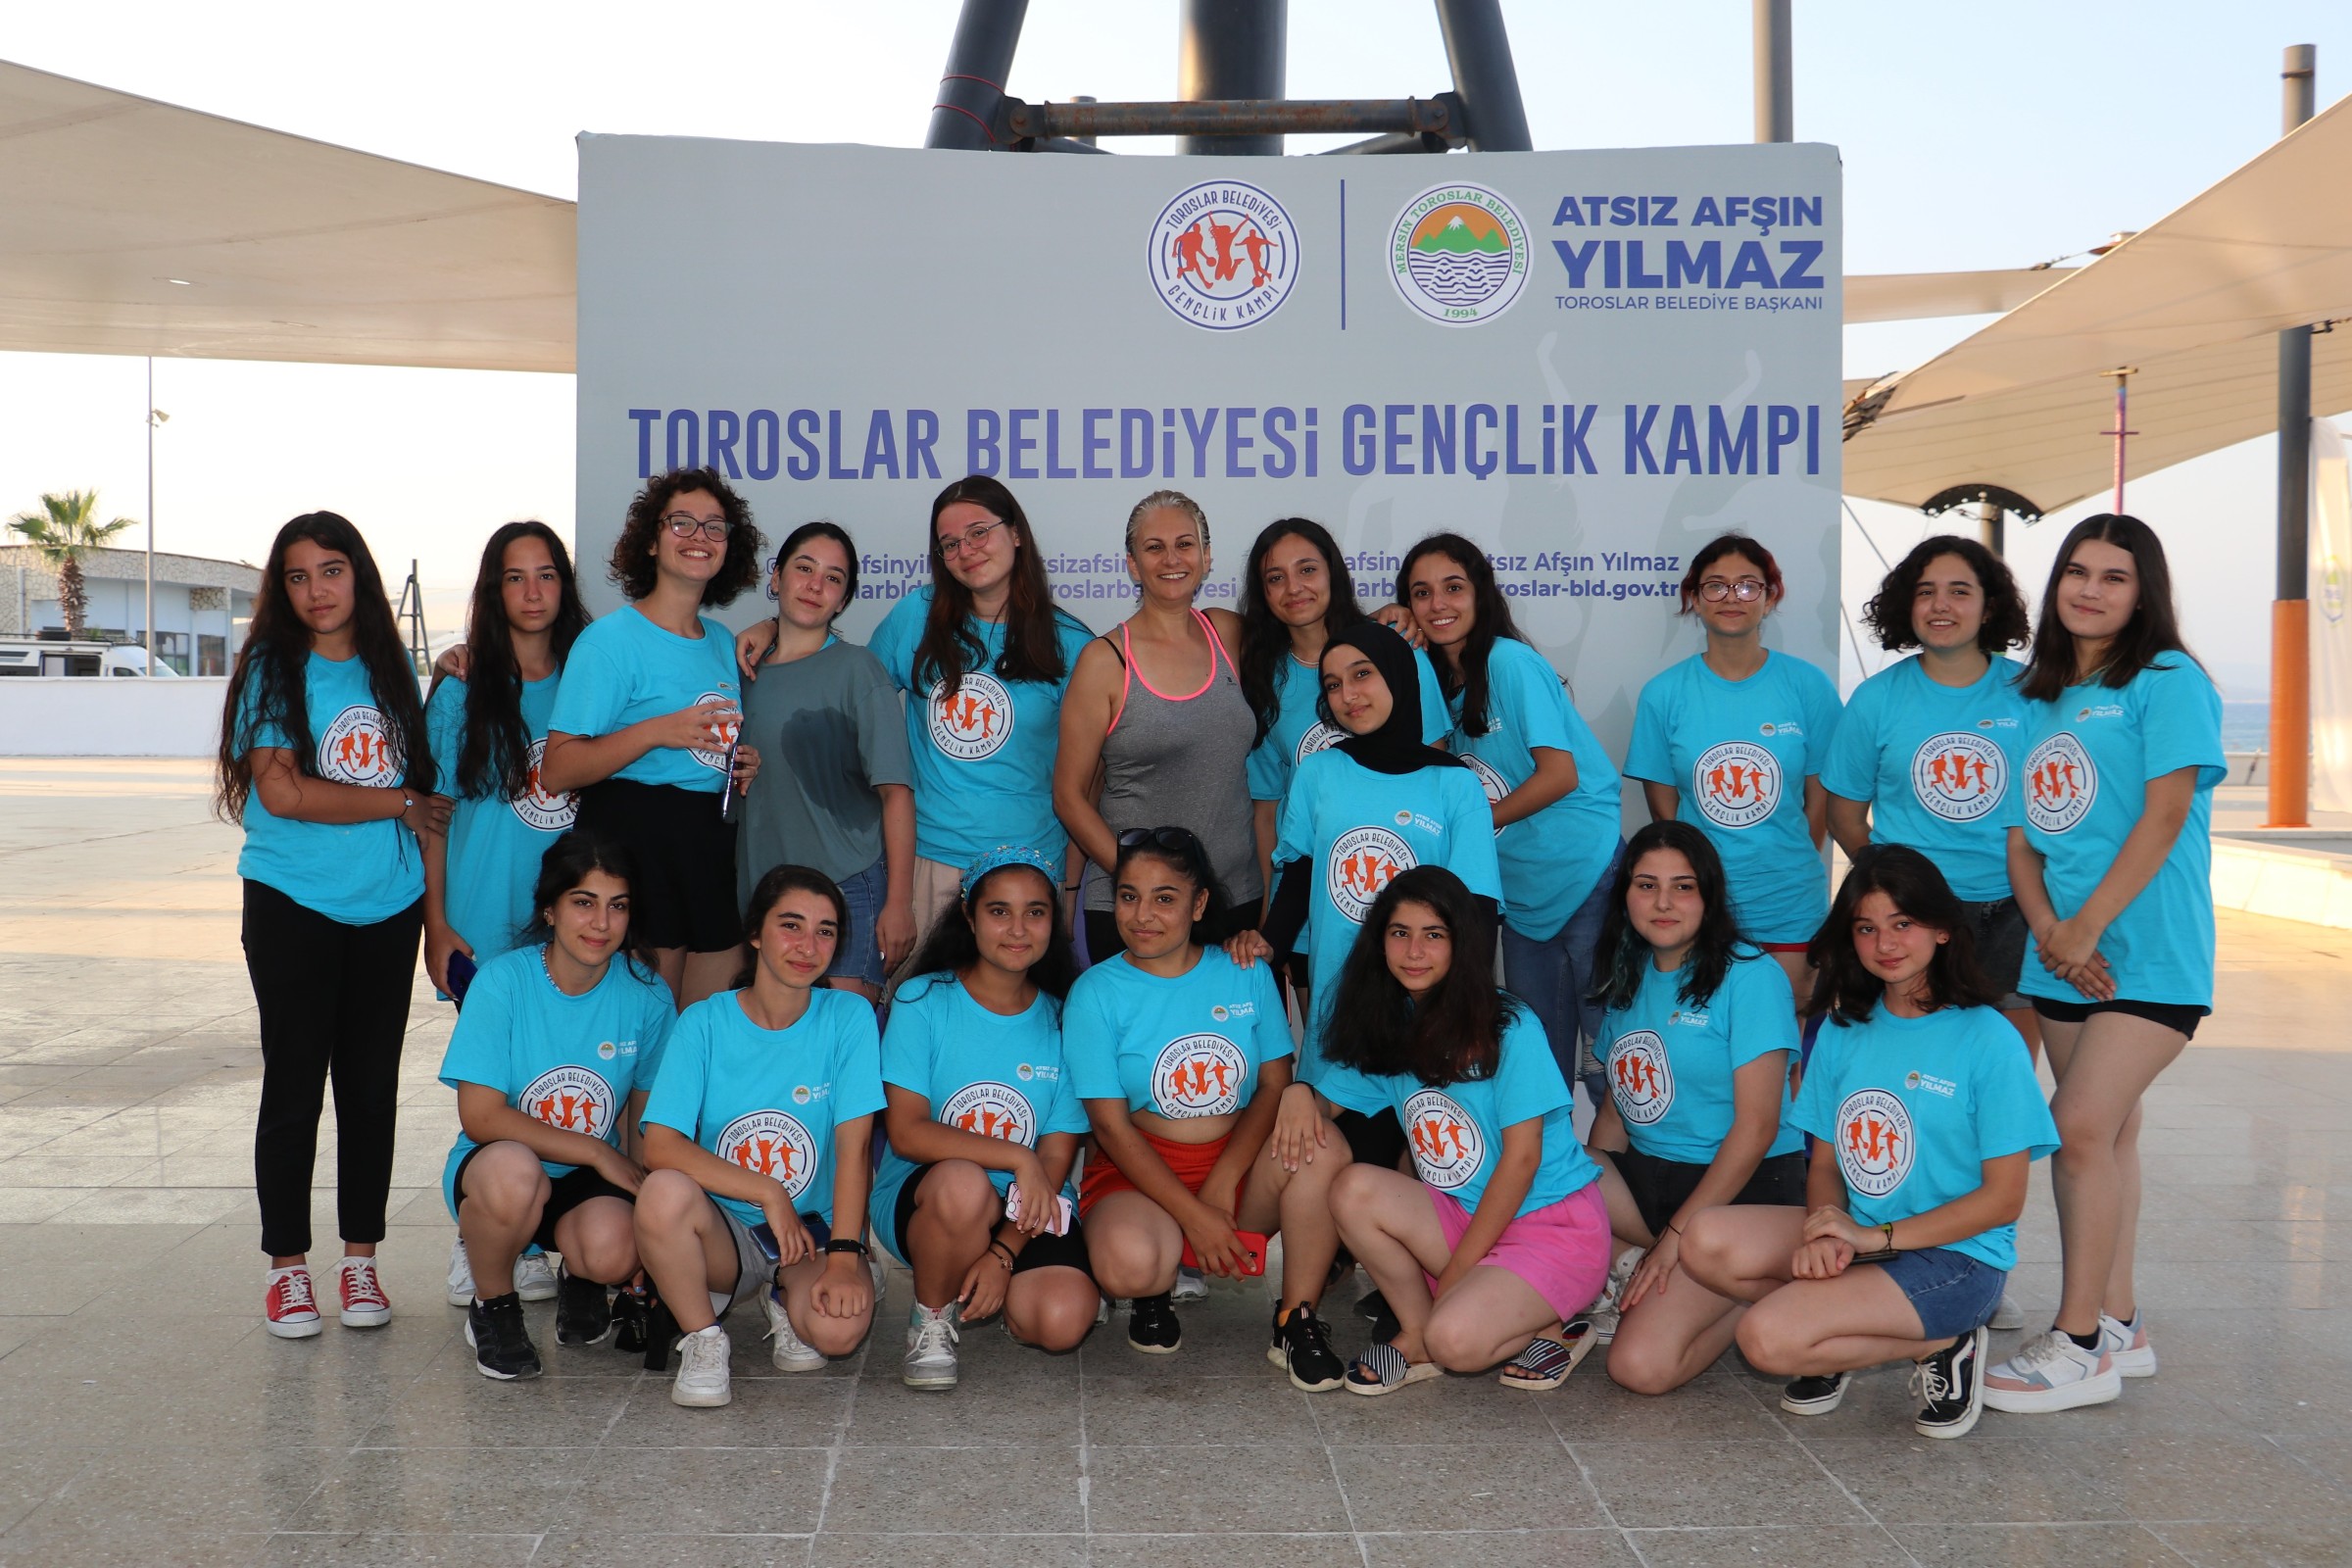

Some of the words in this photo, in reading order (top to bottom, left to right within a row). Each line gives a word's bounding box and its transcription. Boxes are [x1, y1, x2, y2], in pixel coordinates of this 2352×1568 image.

[1165, 190, 1218, 229] TOROSLAR
[1551, 196, 1678, 226] ATSIZ
[1690, 196, 1822, 236] AFŞIN
[1396, 220, 1413, 274] MERSİN
[1410, 190, 1483, 219] TOROSLAR
[1486, 199, 1525, 275] BELEDİYESİ
[1551, 240, 1824, 289] YILMAZ
[1236, 285, 1280, 319] KAMPI
[1555, 296, 1649, 310] TOROSLAR
[1655, 293, 1739, 310] BELEDİYE
[1744, 296, 1823, 314] BAŞKANI
[1444, 308, 1478, 318] 1994
[628, 408, 943, 481] TOROSLAR
[1625, 405, 1820, 475] KAMPI
[1485, 553, 1527, 571] tsız
[1534, 552, 1593, 576] Afşın
[1601, 552, 1680, 571] Yılmaz
[1499, 579, 1680, 601] roslar-bld.gov.tr
[969, 738, 996, 755] KAMPI
[1702, 746, 1734, 767] TOROSLAR
[1745, 800, 1772, 820] KAMPI
[1967, 793, 1994, 813] KAMPI
[1414, 817, 1442, 835] YILMAZ
[1336, 833, 1369, 856] TOROSLAR
[1230, 1006, 1255, 1016] YILMA
[1162, 1043, 1192, 1070] TOROSLAR
[1613, 1036, 1642, 1056] TOROSLAR
[530, 1072, 565, 1098] TOROSLAR
[1920, 1080, 1955, 1096] YILMAZ
[954, 1089, 990, 1110] TOROSLAR
[1208, 1094, 1235, 1115] KAMPI
[1842, 1096, 1874, 1119] TOROSLAR
[727, 1118, 761, 1143] TOROSLAR
[1877, 1170, 1900, 1190] KAMPI
